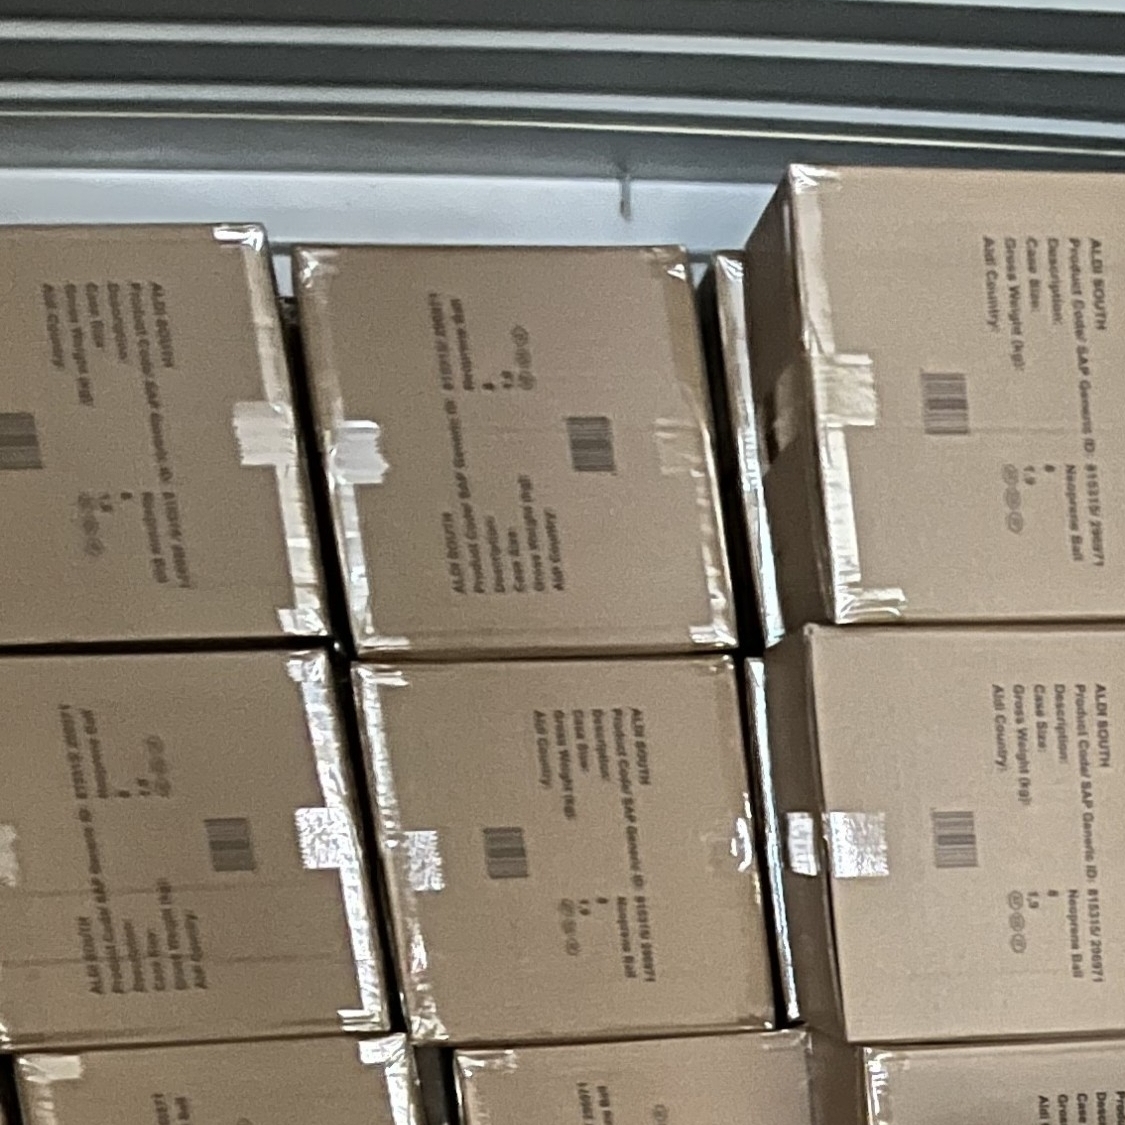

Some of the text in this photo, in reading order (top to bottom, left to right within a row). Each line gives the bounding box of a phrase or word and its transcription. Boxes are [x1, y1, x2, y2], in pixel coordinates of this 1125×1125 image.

[982, 236, 996, 265] Aldi
[1004, 236, 1016, 280] Gross
[1025, 236, 1038, 273] Case
[1068, 238, 1083, 295] Product
[1089, 238, 1107, 330] ALDI SOUTH
[1007, 285, 1022, 335] Weight
[1072, 299, 1087, 341] Code/
[1076, 345, 1089, 375] SAP
[1078, 379, 1092, 434] Generic
[1064, 464, 1079, 530] Neoprene
[1070, 535, 1083, 561] Ball
[1013, 684, 1024, 723] Gross
[1033, 683, 1045, 716] Case
[1074, 684, 1088, 735] Product
[631, 708, 650, 784] ALDI SOUTH
[992, 684, 1007, 770] Aldi Country:
[1095, 684, 1110, 767] ALDI SOUTH
[1015, 727, 1029, 773] Weight
[1078, 739, 1091, 777] Code/
[1080, 781, 1093, 808] SAP
[1054, 684, 1083, 977] Description: Neoprene Ball
[1082, 812, 1094, 861] Generic
[1037, 1095, 1050, 1119] Aldi
[1076, 1092, 1087, 1123] Case
